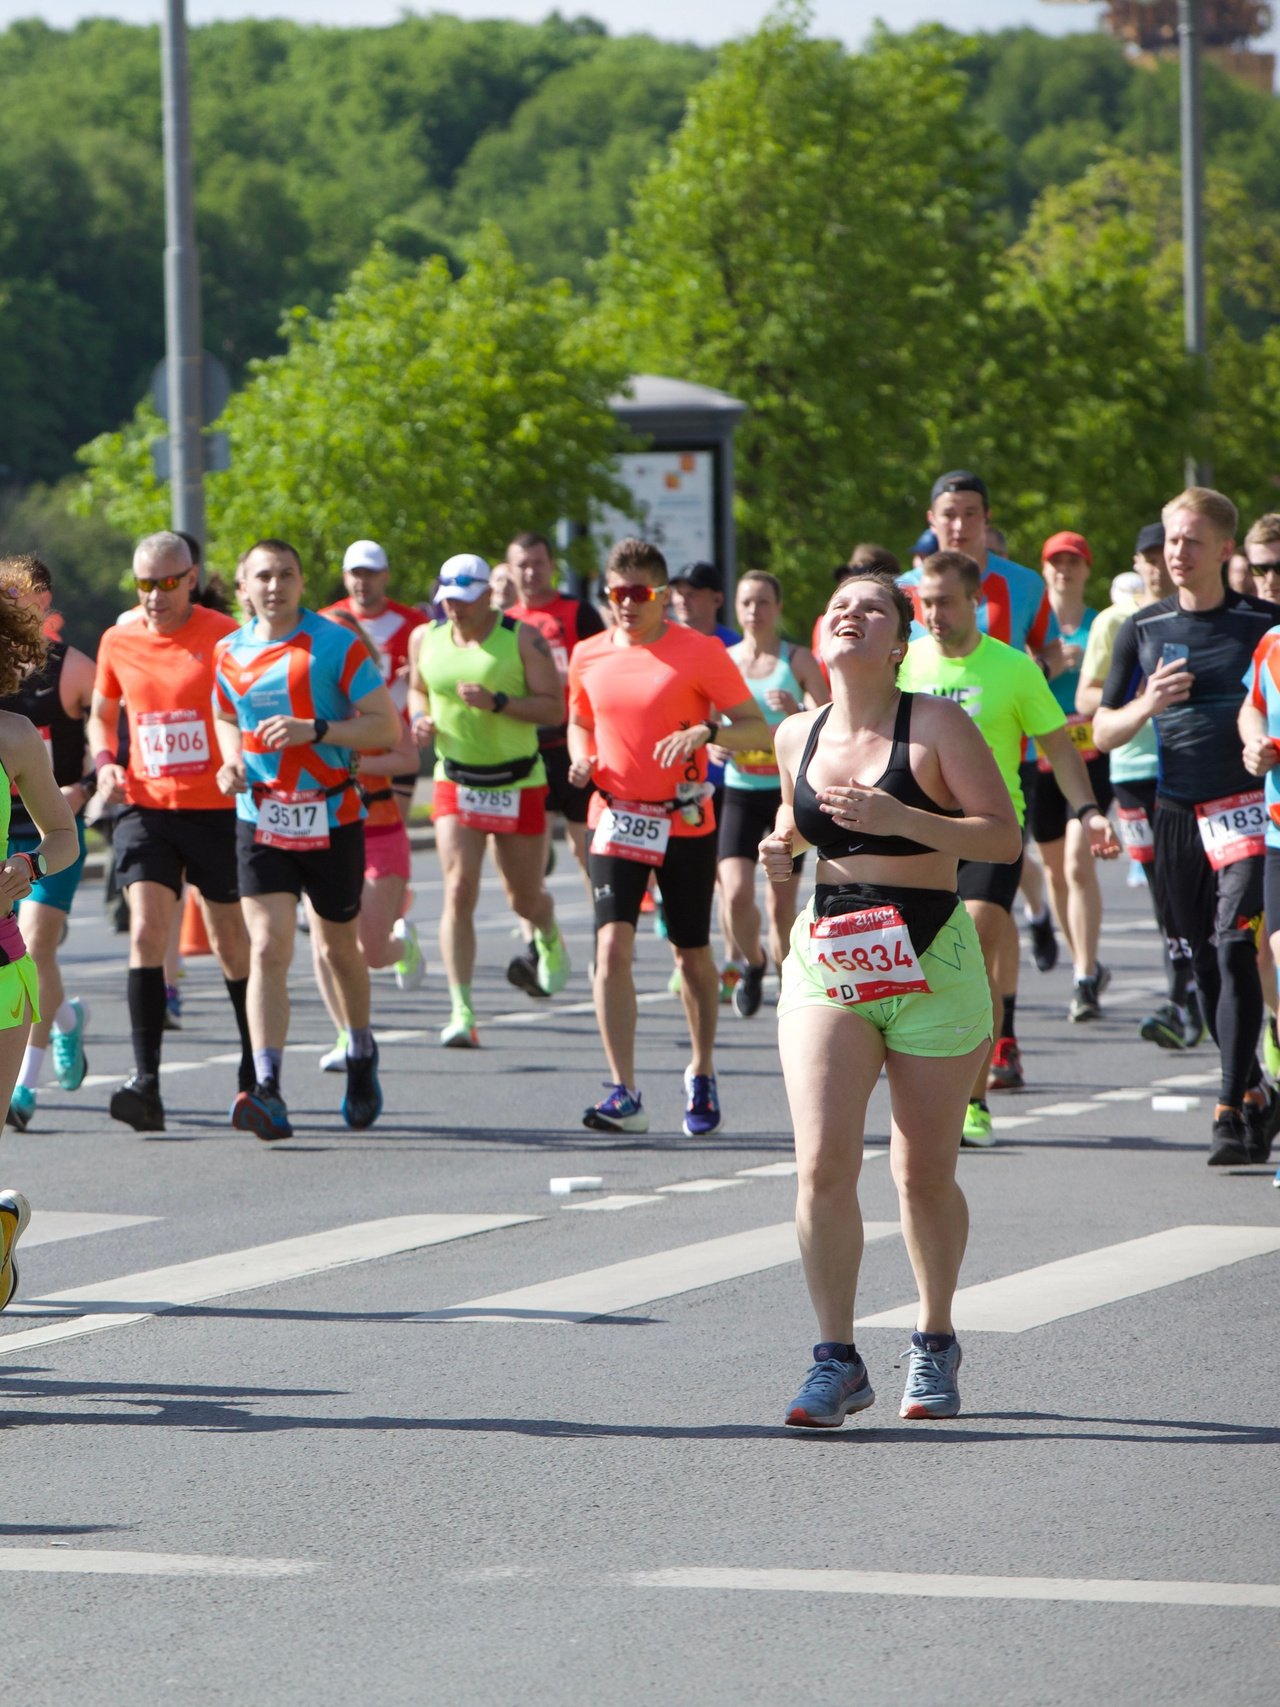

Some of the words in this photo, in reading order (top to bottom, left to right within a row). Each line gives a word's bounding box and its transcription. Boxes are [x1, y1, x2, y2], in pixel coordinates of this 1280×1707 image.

[144, 730, 204, 755] 14906
[267, 803, 318, 828] 3517
[1204, 806, 1271, 838] 1183
[817, 940, 914, 973] 15834
[840, 984, 855, 1000] D
